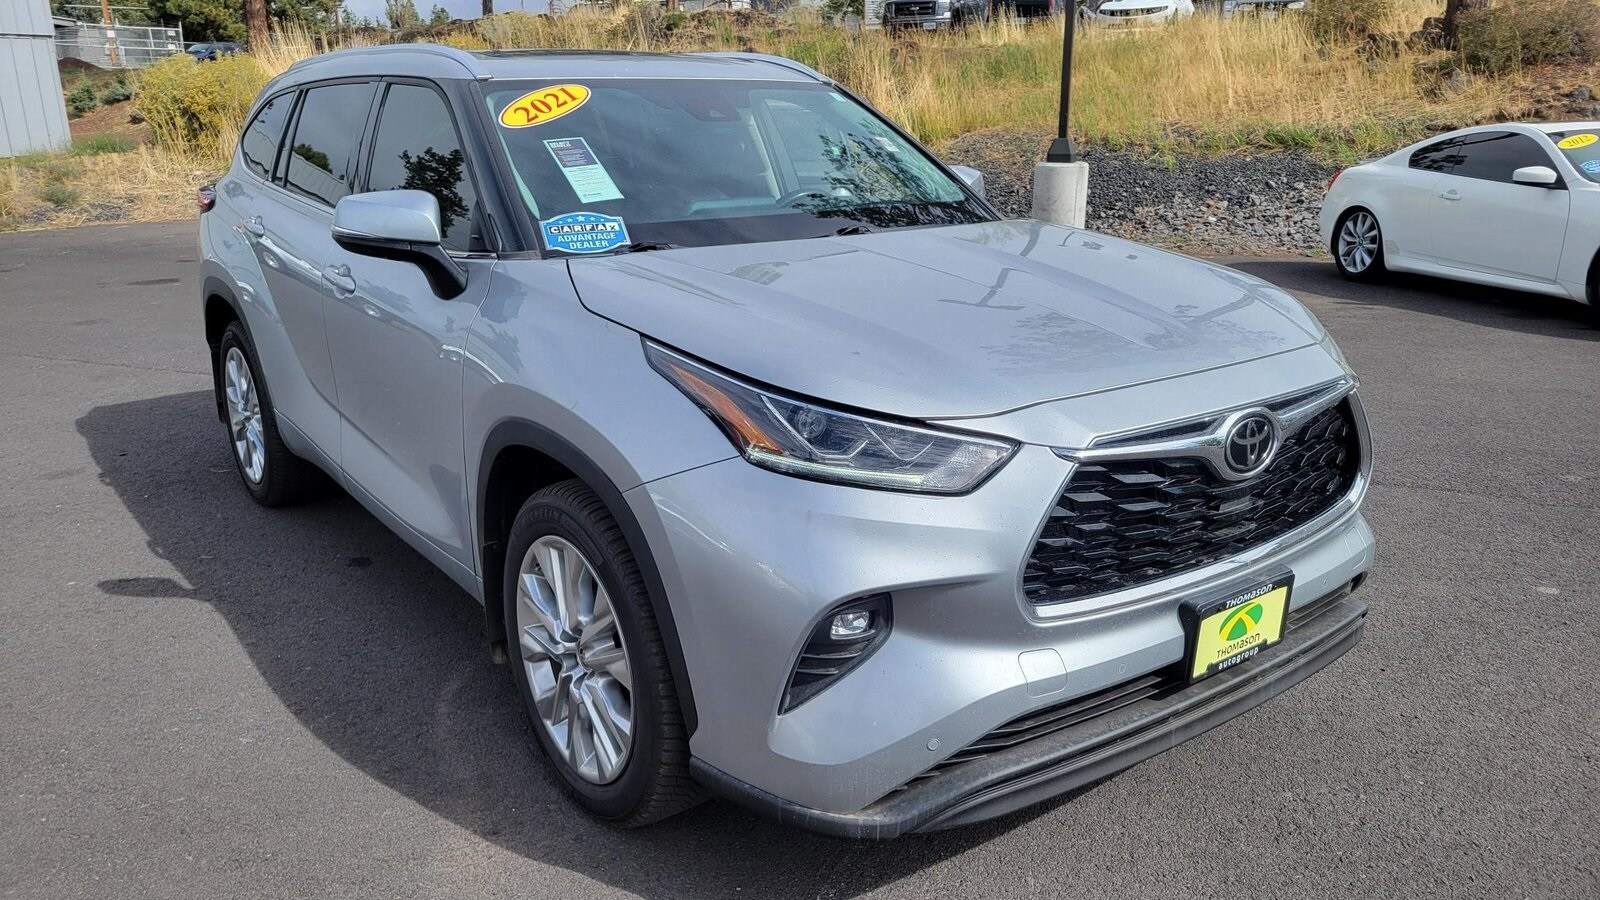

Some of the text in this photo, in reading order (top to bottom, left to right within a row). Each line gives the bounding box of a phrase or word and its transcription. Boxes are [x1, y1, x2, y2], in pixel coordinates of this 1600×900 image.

[514, 87, 580, 123] 2021
[1564, 135, 1591, 147] 2012
[549, 222, 619, 235] CARFAX
[557, 232, 617, 243] ADVANTAGE
[569, 240, 609, 250] DEALER
[1218, 646, 1259, 670] autogroup
